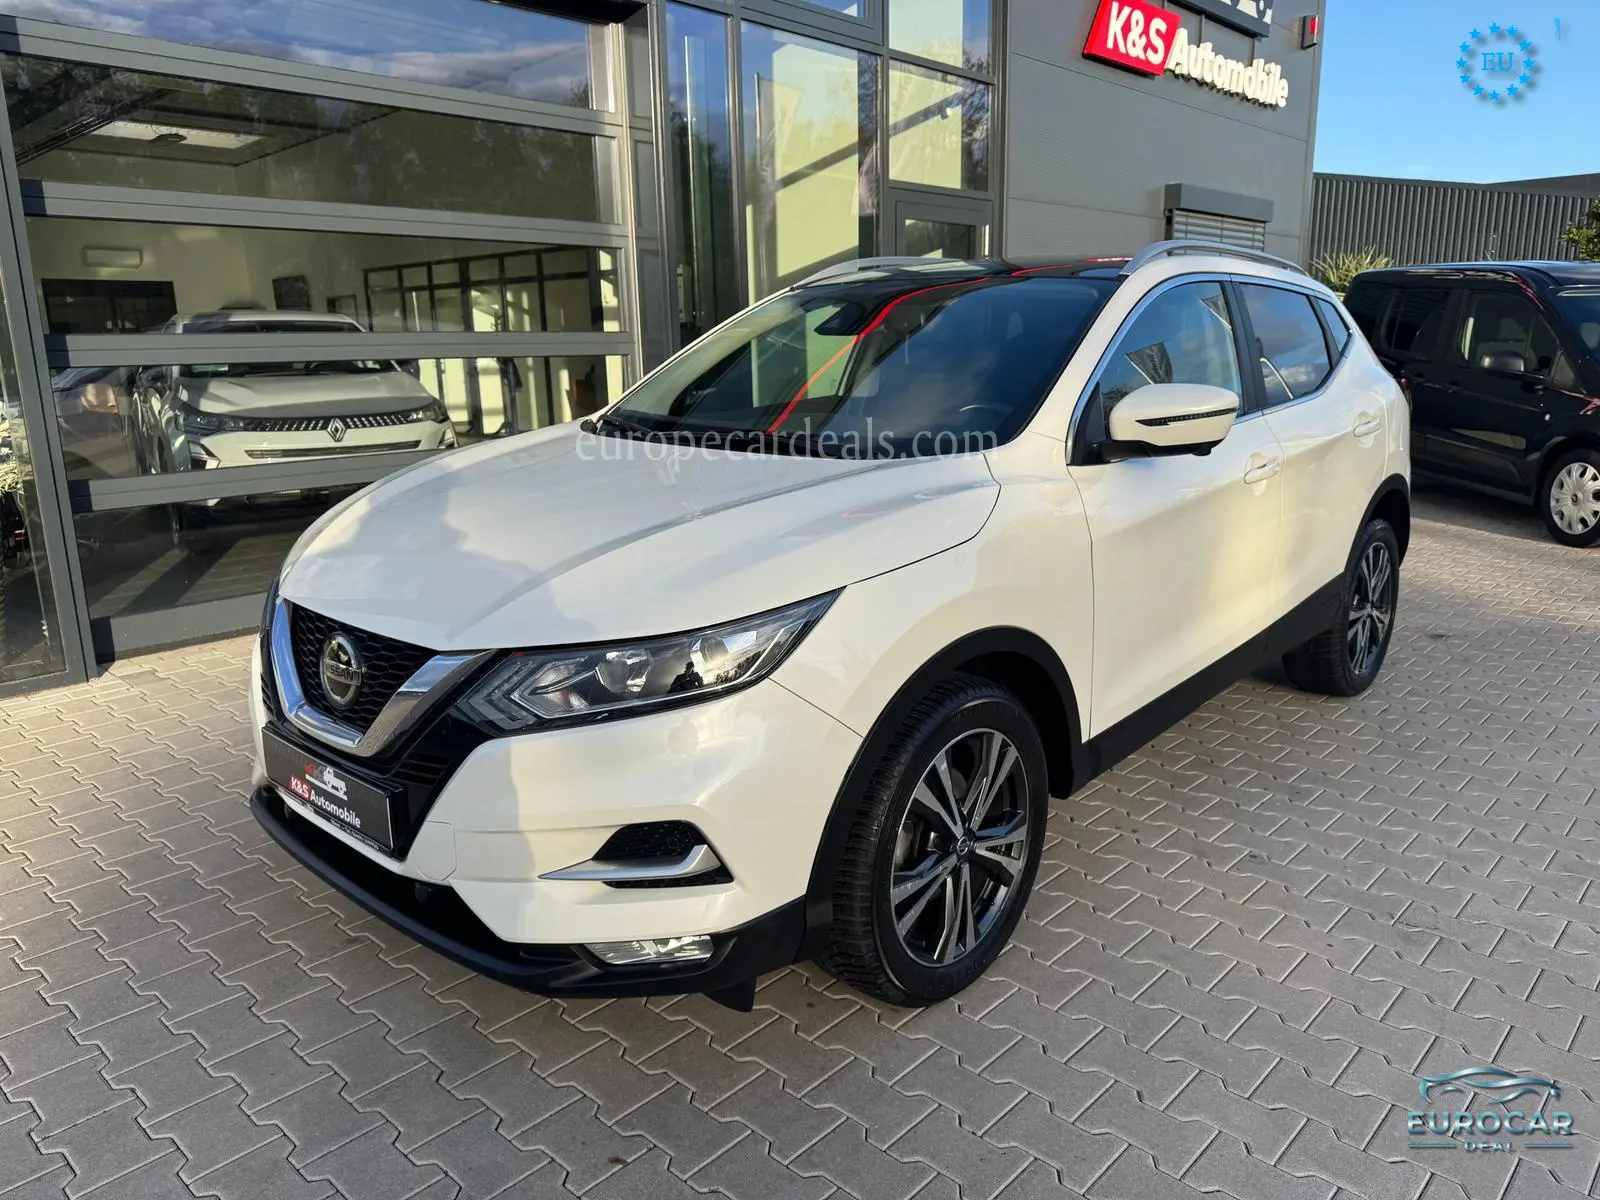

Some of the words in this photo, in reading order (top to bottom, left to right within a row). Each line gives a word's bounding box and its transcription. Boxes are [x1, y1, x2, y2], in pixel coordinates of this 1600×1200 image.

[1106, 1, 1168, 66] K&S
[1165, 27, 1289, 107] Automobile
[291, 776, 309, 799] K&S
[310, 789, 361, 828] Automobile
